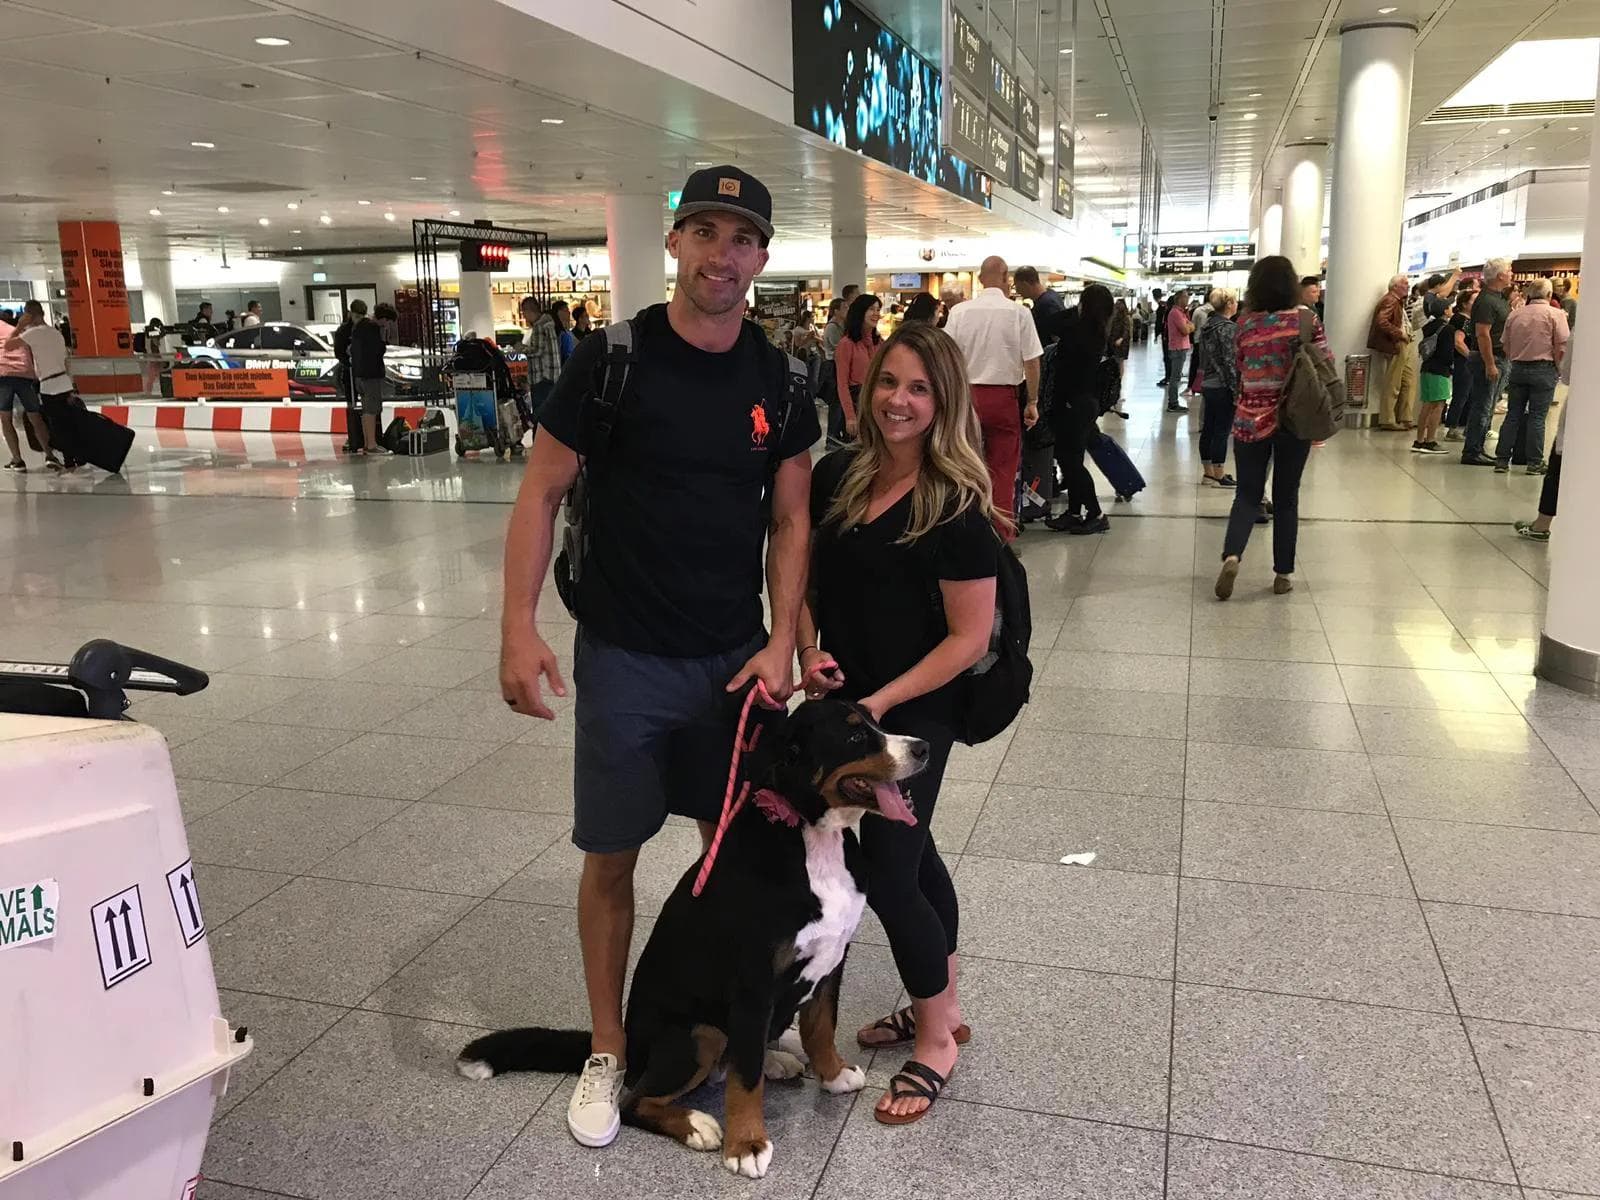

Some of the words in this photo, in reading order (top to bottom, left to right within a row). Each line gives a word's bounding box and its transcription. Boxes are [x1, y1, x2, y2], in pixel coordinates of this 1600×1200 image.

[245, 359, 271, 370] BMW
[272, 359, 297, 370] Bank
[300, 369, 318, 377] DTM
[203, 381, 215, 390] Das
[0, 907, 55, 946] MALS
